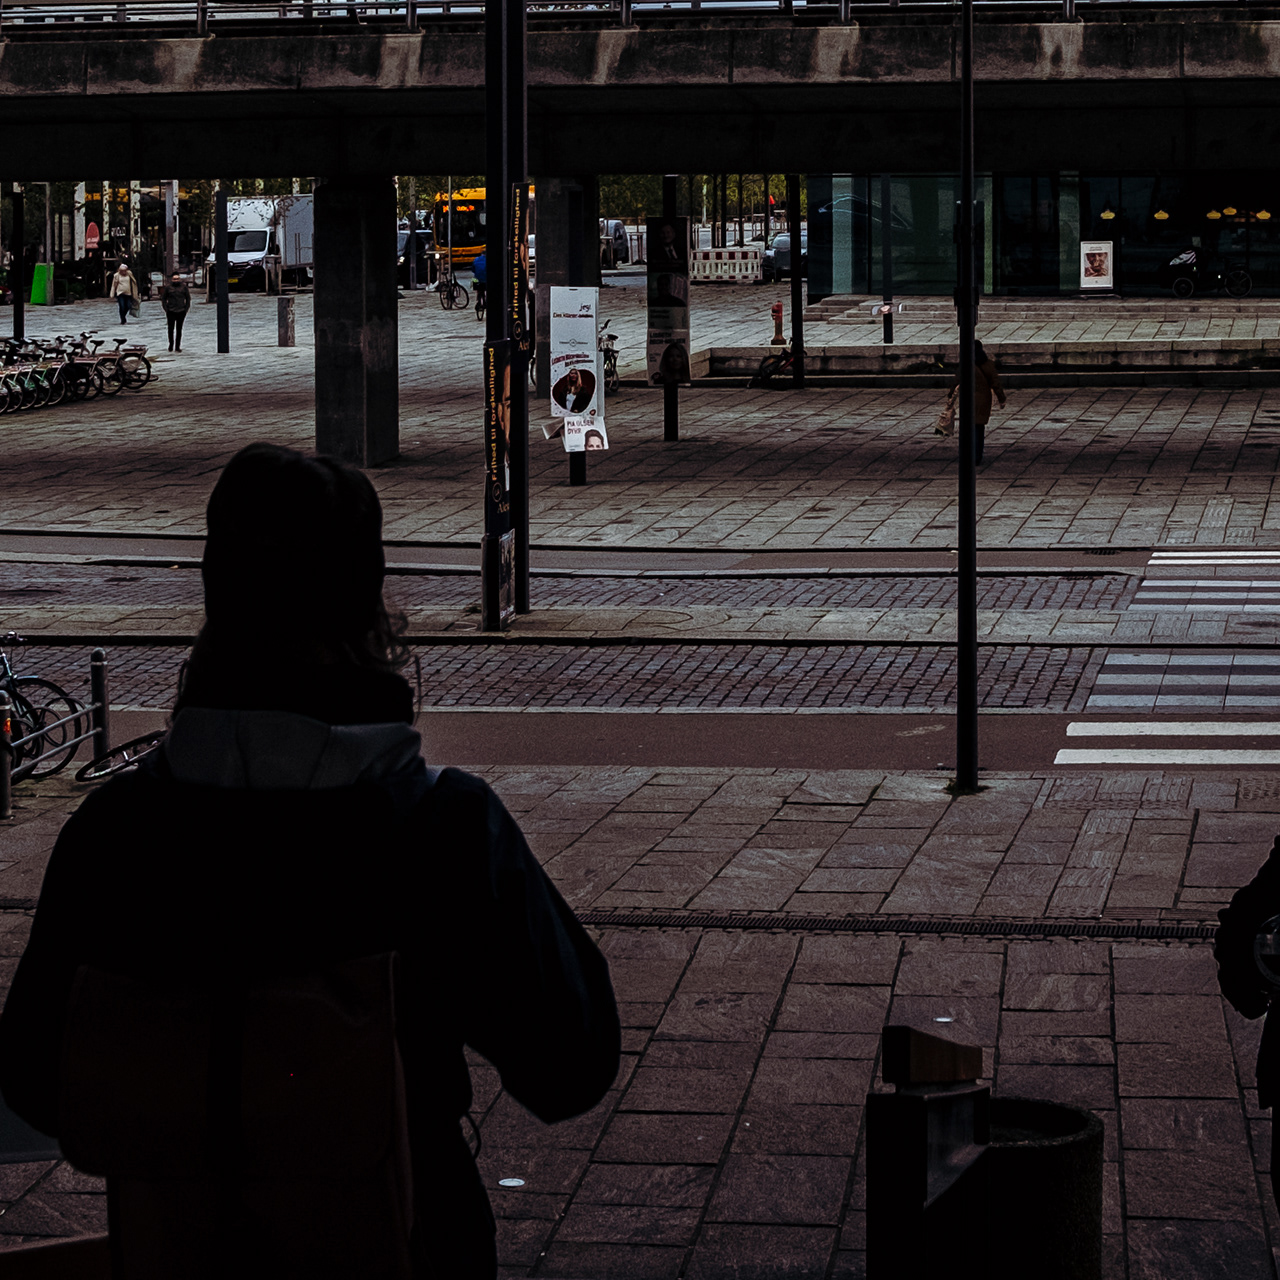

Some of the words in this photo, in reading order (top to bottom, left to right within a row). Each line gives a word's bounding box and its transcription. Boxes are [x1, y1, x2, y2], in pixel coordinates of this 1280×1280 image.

[487, 348, 497, 425] forskellighed
[489, 428, 497, 440] til
[489, 442, 498, 481] Frihed
